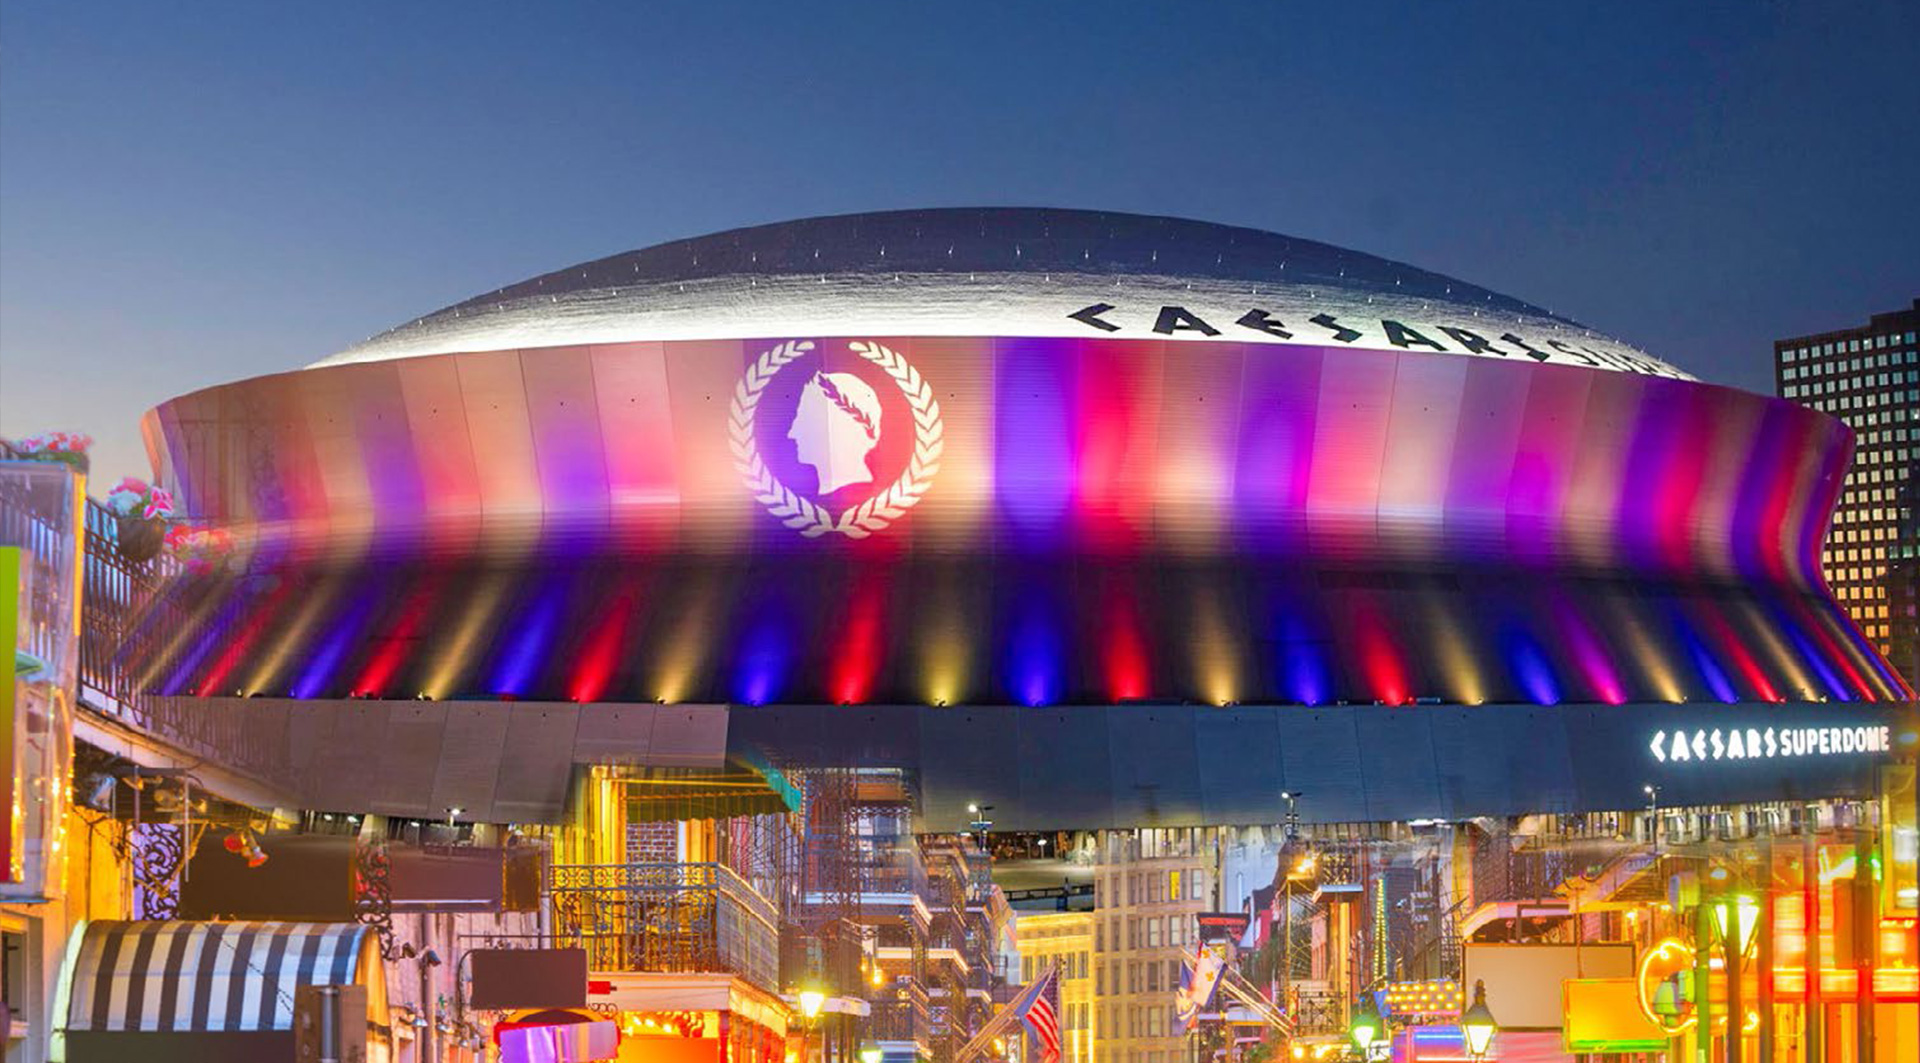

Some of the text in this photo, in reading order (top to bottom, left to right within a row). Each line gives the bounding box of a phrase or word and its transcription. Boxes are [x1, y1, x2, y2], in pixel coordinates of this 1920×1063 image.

[1067, 303, 1550, 363] CAESARS
[1649, 726, 1890, 763] CAESARS SUPERDOME
